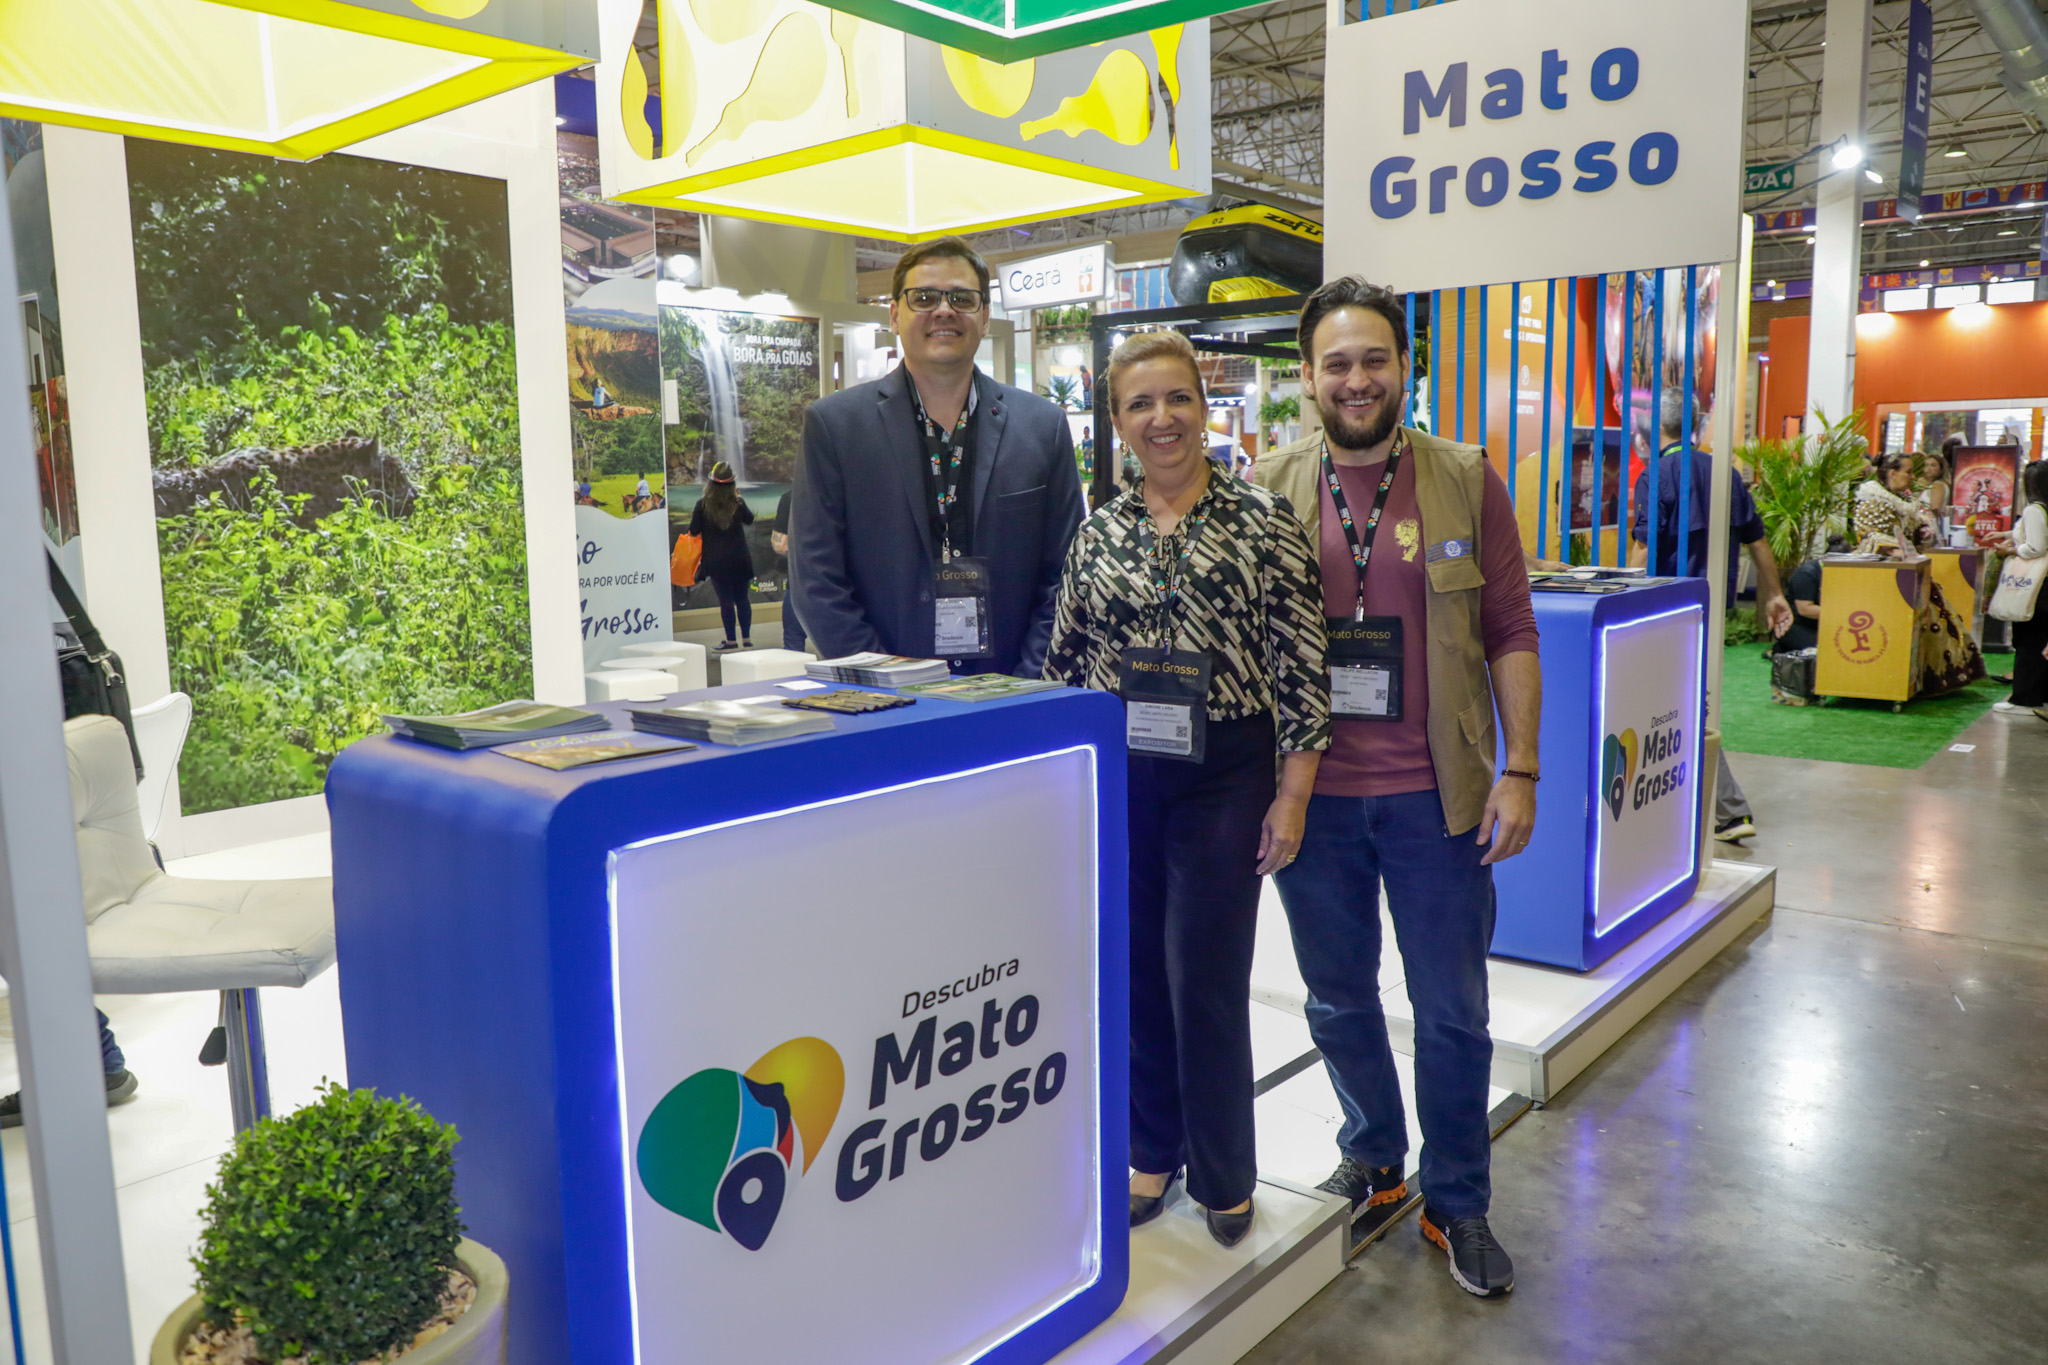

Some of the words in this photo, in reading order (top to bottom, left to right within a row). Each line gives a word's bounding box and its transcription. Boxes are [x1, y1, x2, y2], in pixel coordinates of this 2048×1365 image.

[1403, 47, 1639, 135] Mato
[1915, 71, 1928, 113] E
[1370, 131, 1679, 219] Grosso
[1744, 169, 1779, 190] ÍDA
[1009, 263, 1061, 292] Ceará
[733, 346, 764, 364] BORA
[765, 352, 781, 364] PRA
[1975, 523, 1997, 531] ATAL
[579, 577, 591, 588] RA
[593, 576, 613, 588] POR
[615, 571, 639, 586] VOCÊ
[640, 573, 654, 584] EM
[942, 570, 978, 581] Grosso
[1327, 630, 1352, 639] Mato
[1354, 629, 1391, 639] Grosso
[1132, 661, 1160, 672] Mato
[1162, 662, 1199, 676] Grosso
[1651, 709, 1679, 729] Descubra
[1139, 739, 1176, 747] EXPOSITOR
[1642, 728, 1682, 768] Mato
[1633, 761, 1686, 811] Grosso
[901, 958, 1020, 1019] Descubra
[869, 994, 1040, 1110] Mato
[835, 1051, 1068, 1203] Grosso
